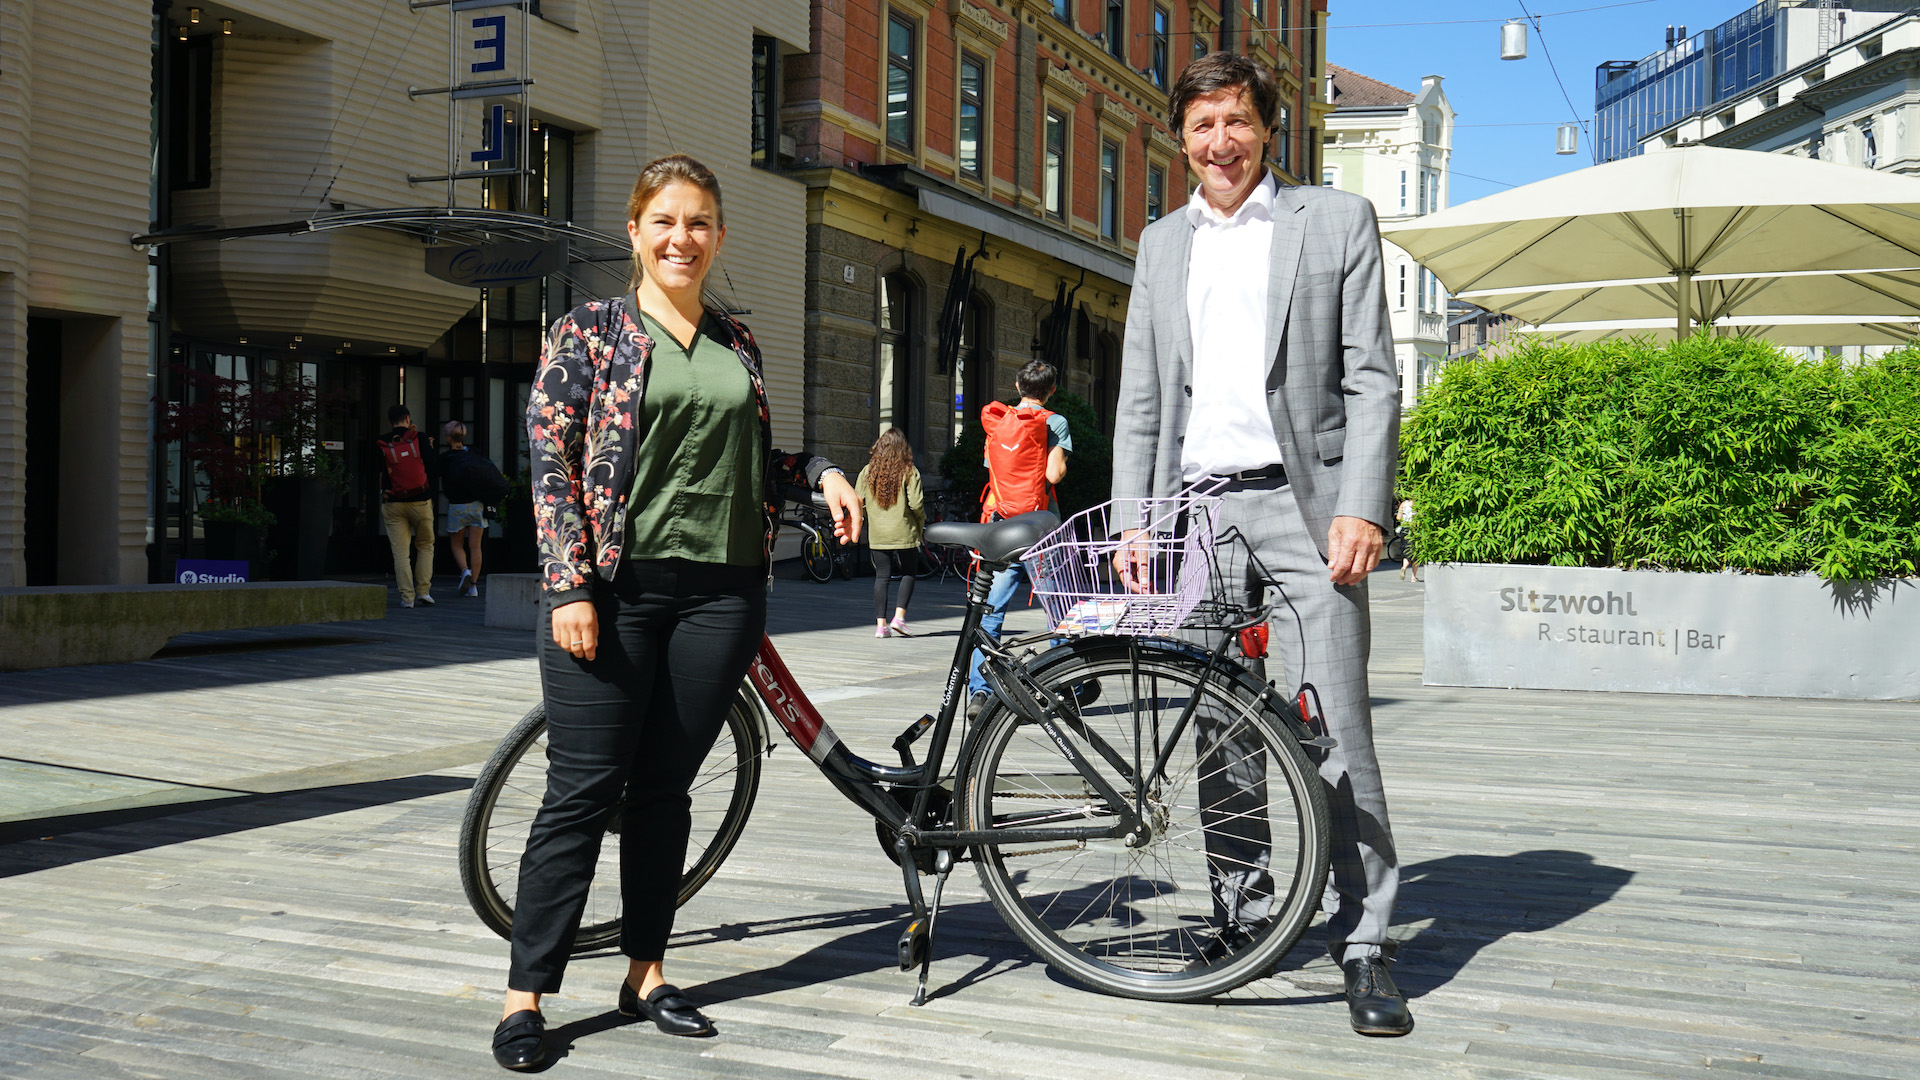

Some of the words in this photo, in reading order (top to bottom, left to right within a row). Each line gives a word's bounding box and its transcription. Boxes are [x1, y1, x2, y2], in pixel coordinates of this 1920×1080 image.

[450, 249, 543, 283] Central
[199, 573, 245, 583] Studio
[1500, 587, 1637, 616] Sitzwohl
[1687, 630, 1725, 650] Bar
[943, 666, 960, 706] Coventry
[1044, 722, 1057, 738] High
[1056, 737, 1075, 760] Quality
